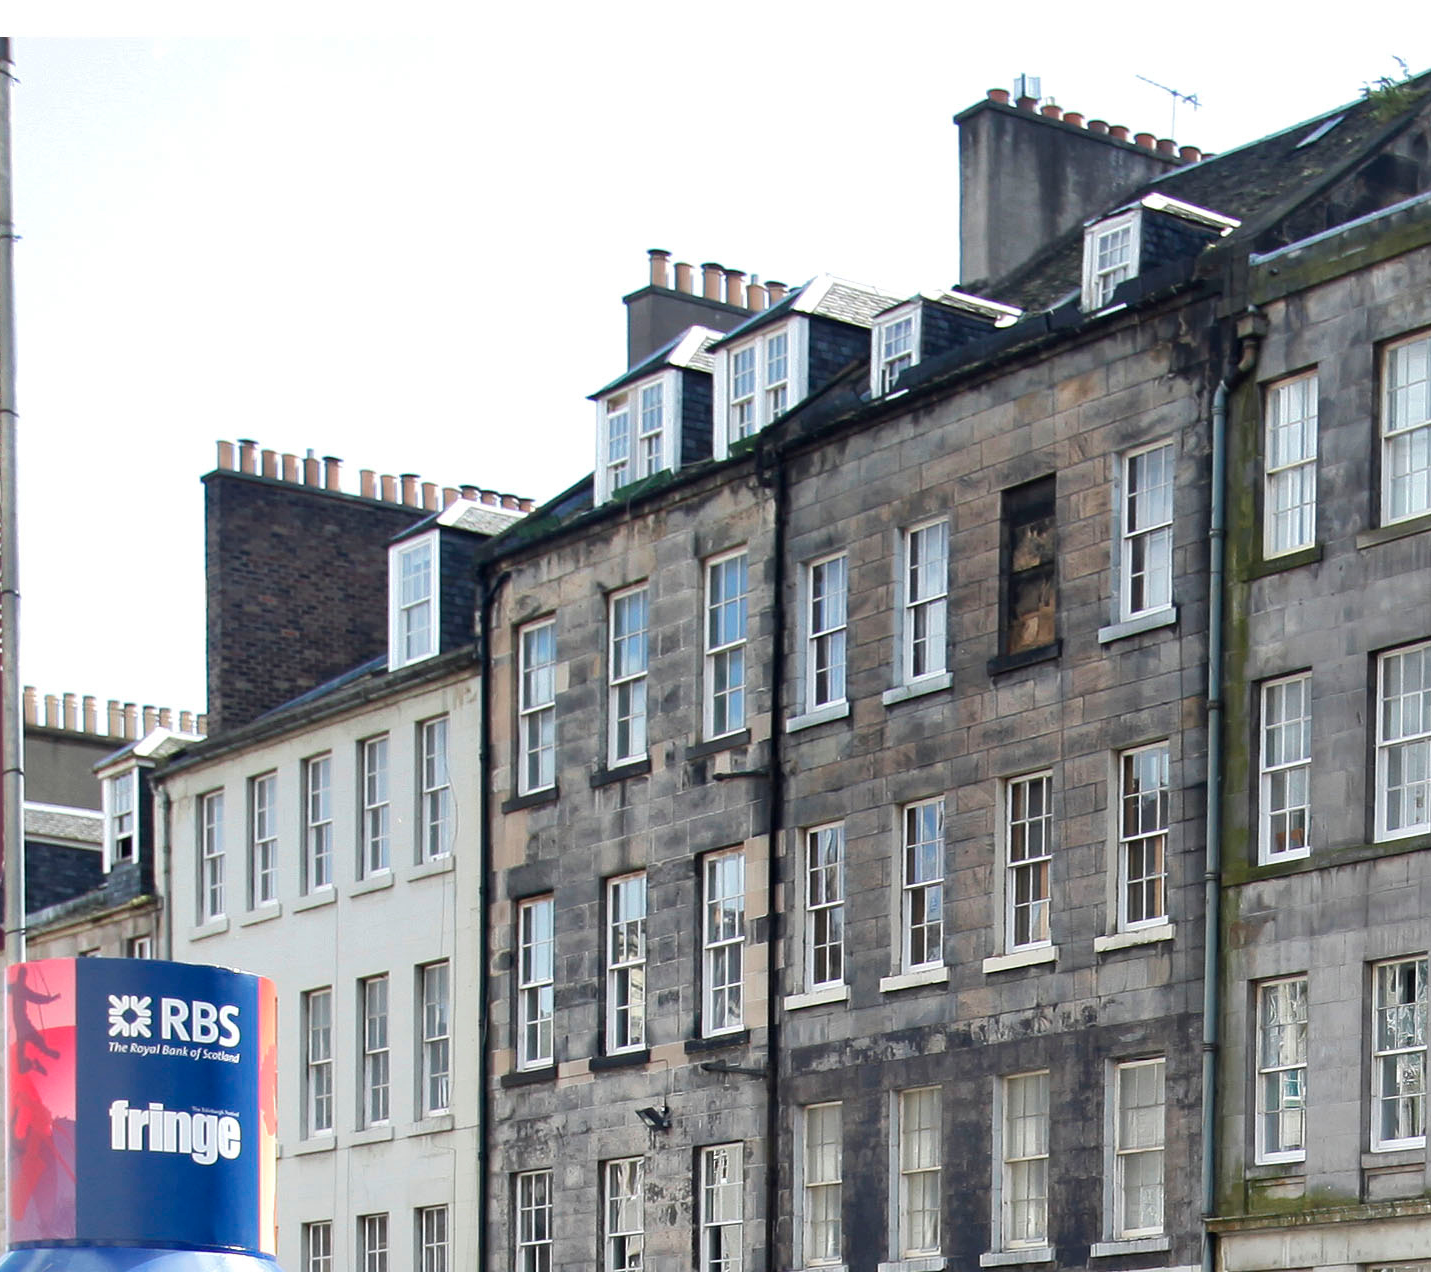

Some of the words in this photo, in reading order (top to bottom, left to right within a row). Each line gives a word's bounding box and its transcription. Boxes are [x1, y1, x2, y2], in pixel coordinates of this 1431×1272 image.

[161, 998, 240, 1048] RBS
[108, 1042, 127, 1053] The
[130, 1043, 157, 1057] Royal
[161, 1044, 187, 1057] Bank
[189, 1046, 201, 1060] of
[202, 1048, 240, 1063] Scotland
[109, 1100, 241, 1166] fringe
